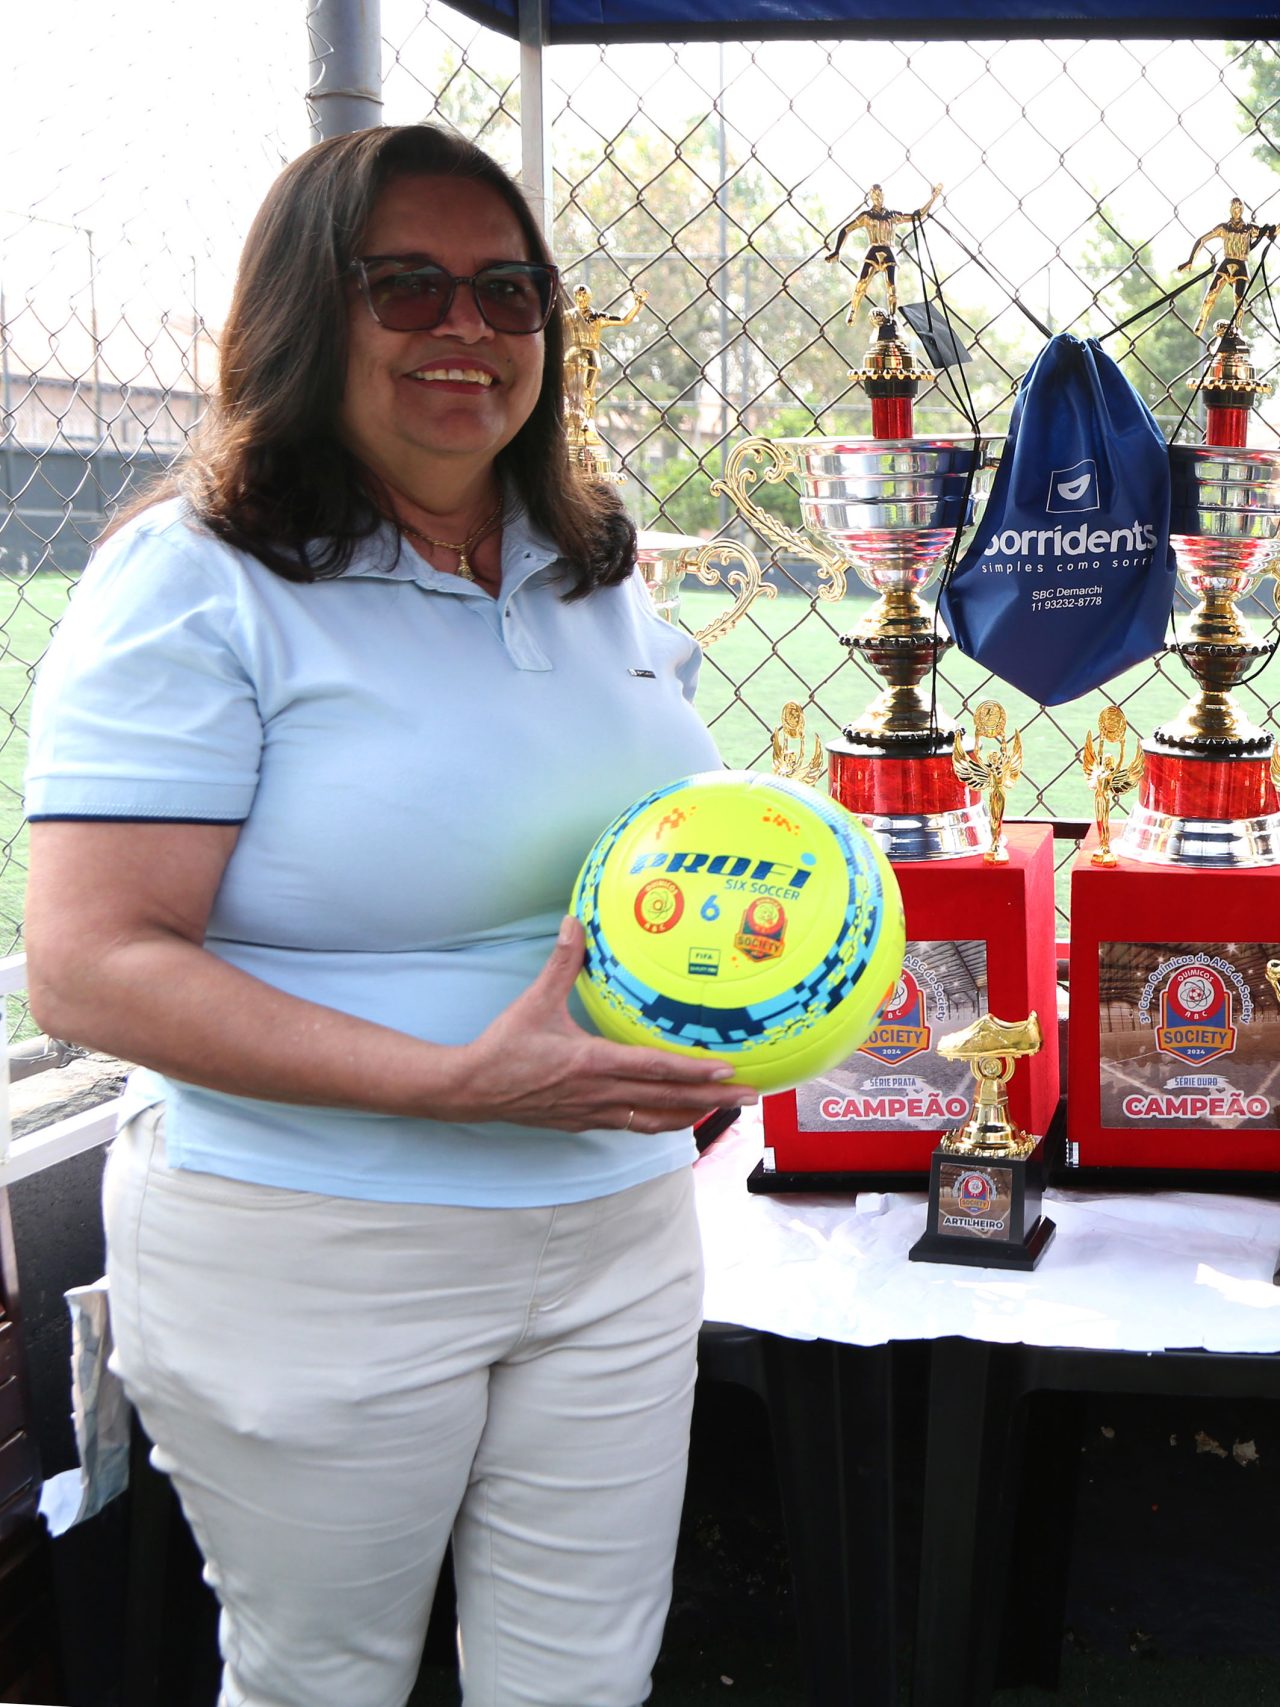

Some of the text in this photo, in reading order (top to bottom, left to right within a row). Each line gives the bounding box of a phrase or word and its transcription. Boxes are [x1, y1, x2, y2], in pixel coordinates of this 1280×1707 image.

[981, 560, 1044, 575] simples
[1056, 560, 1100, 573] como
[1031, 584, 1103, 601] SBC Demarchi
[1032, 596, 1103, 612] 11 93232-8778
[723, 878, 801, 901] SIX SOCCER
[699, 894, 721, 922] 6
[903, 954, 927, 973] ABC
[924, 970, 937, 984] de
[933, 982, 948, 1022] Society
[1138, 983, 1154, 1010] Copa
[1150, 954, 1194, 982] Químicos
[1196, 953, 1210, 964] do
[1212, 957, 1235, 976] ABC
[1231, 971, 1244, 986] de
[1240, 985, 1254, 1025] Society
[1163, 1029, 1228, 1045] SOCIETY
[892, 1078, 917, 1087] PRATA
[1199, 1077, 1218, 1086] OURO
[821, 1092, 967, 1119] CAMPEÃO
[1124, 1092, 1269, 1118] CAMPEÃO
[944, 1216, 1004, 1230] ARTILHEIRO
